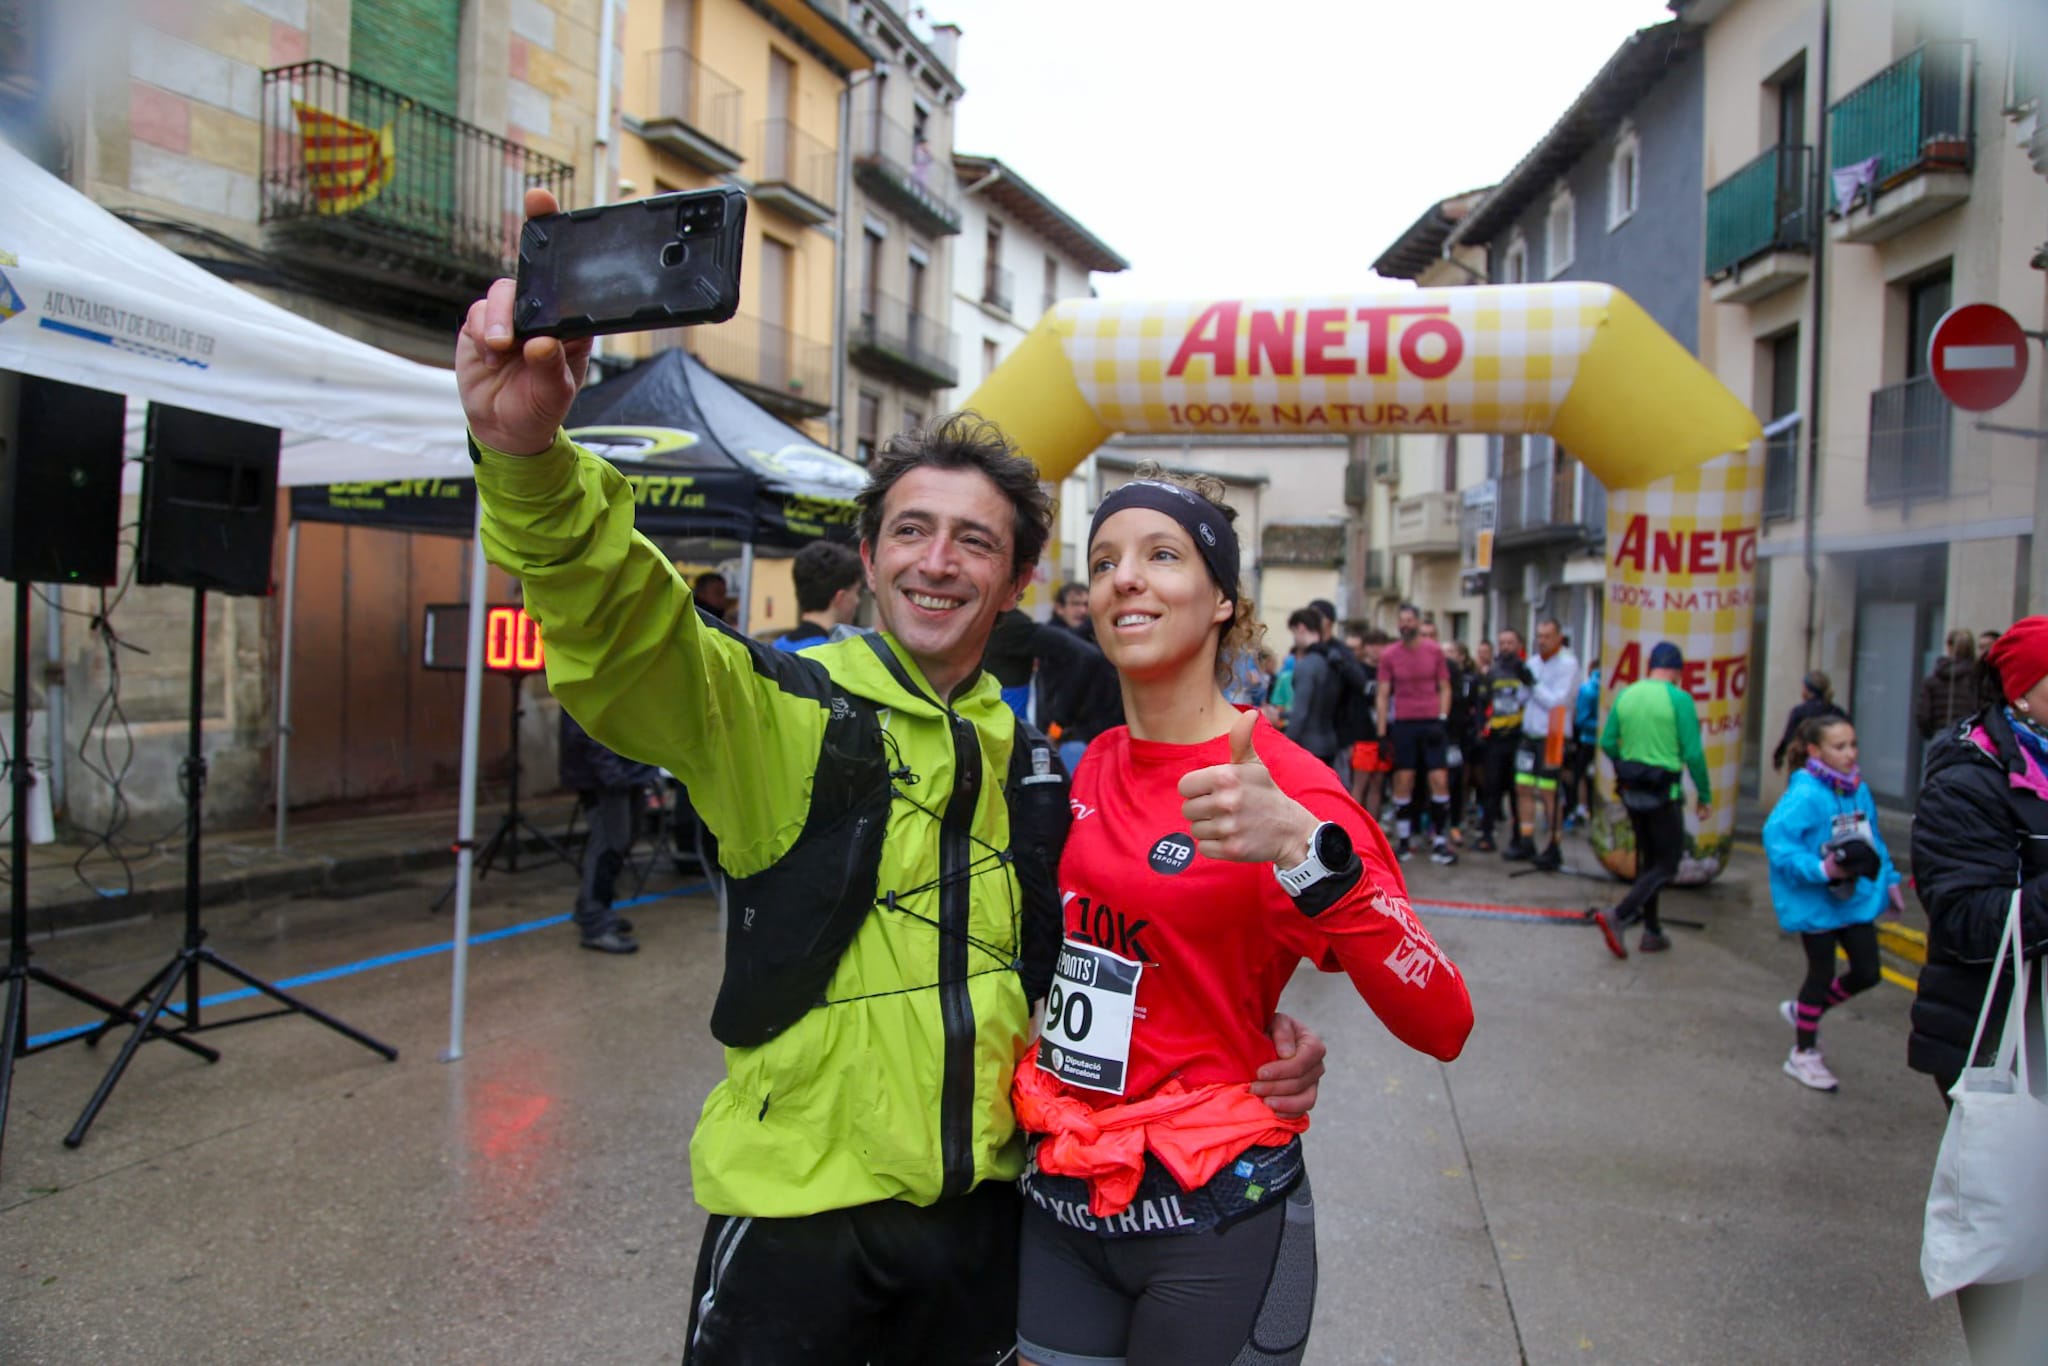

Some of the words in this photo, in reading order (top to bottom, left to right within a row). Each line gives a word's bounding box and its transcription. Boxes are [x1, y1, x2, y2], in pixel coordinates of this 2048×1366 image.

[45, 290, 127, 332] AJUNTAMENT
[128, 313, 145, 337] DE
[1169, 403, 1260, 426] 100%
[1271, 403, 1461, 427] NATURAL
[1609, 641, 1748, 702] AETO
[1152, 854, 1182, 867] ESPORT
[1156, 841, 1190, 861] ETB
[1071, 898, 1150, 961] 10K
[1046, 984, 1092, 1041] 90
[1063, 1064, 1101, 1080] Barcelona
[1064, 1055, 1102, 1072] Diputació
